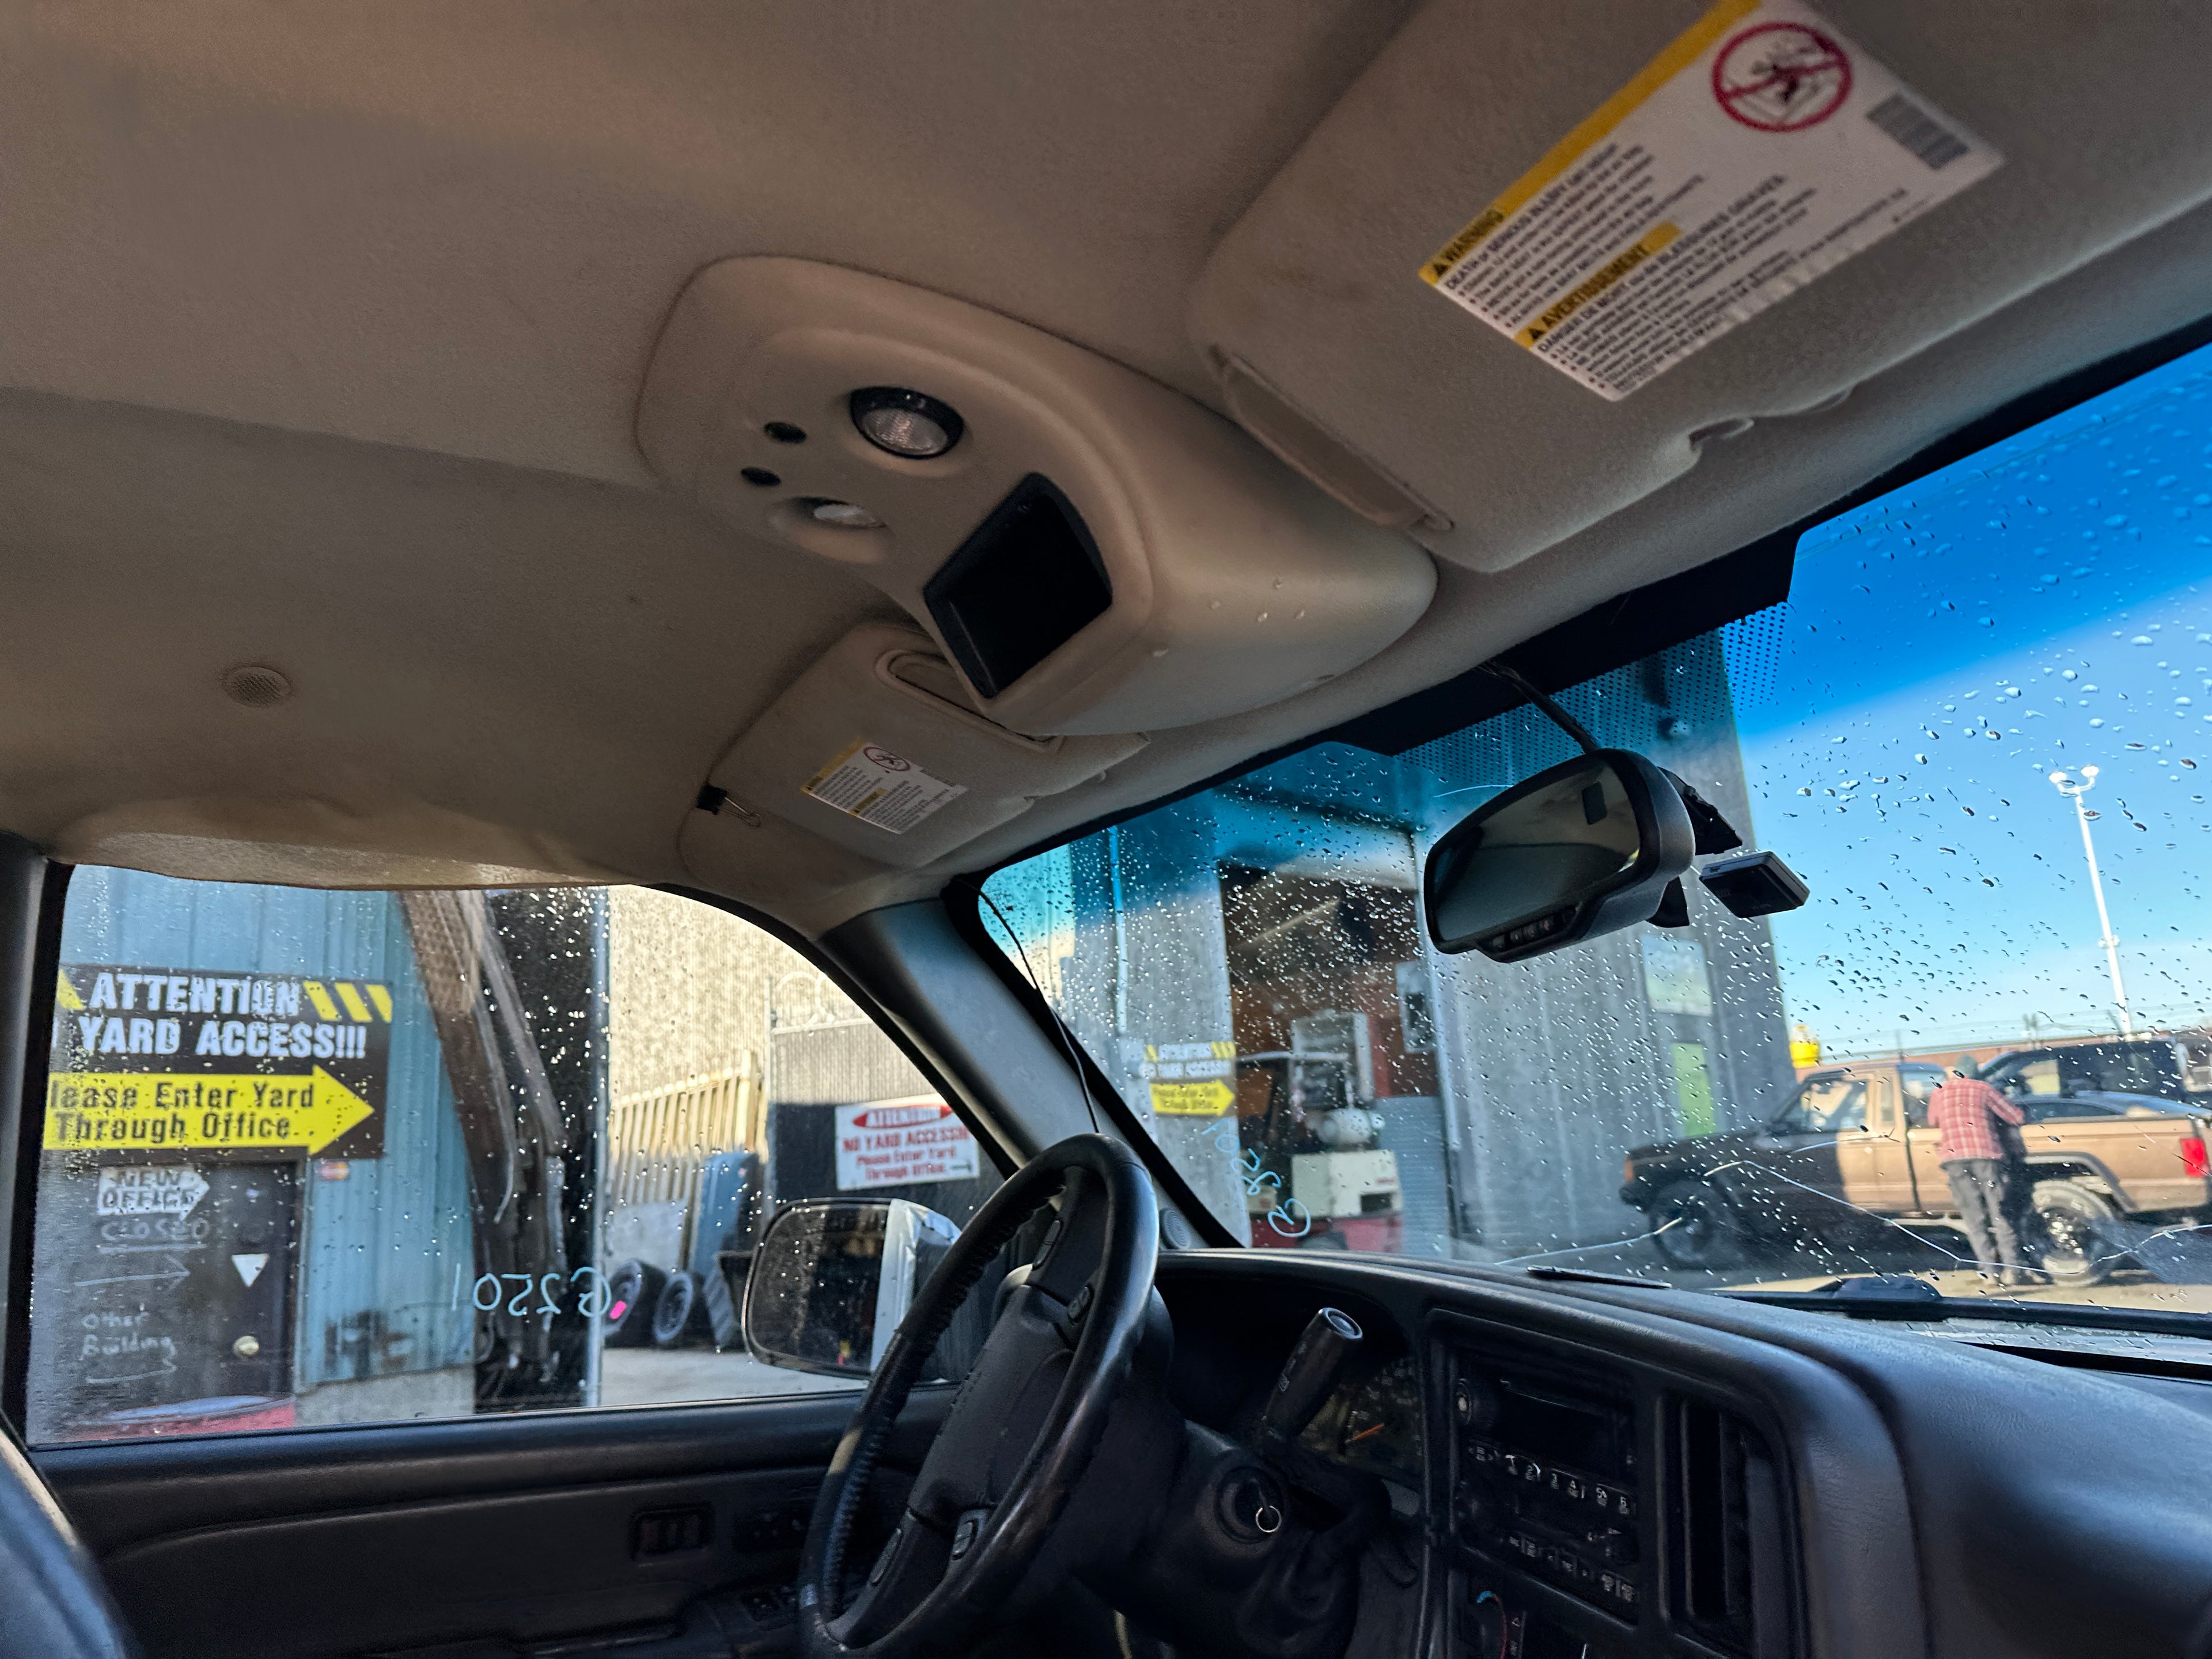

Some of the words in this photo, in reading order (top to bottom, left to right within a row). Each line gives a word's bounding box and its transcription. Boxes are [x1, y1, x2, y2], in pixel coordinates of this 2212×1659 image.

[88, 972, 300, 1016] ATTENTION
[79, 1017, 180, 1055] YARD
[194, 1020, 366, 1059] ACCESS!!!
[51, 1081, 138, 1109] lease
[156, 1082, 238, 1109] Enter
[253, 1082, 315, 1108] Yard
[55, 1112, 186, 1144] Through
[202, 1111, 291, 1139] Office
[102, 1187, 196, 1210] OFFICE
